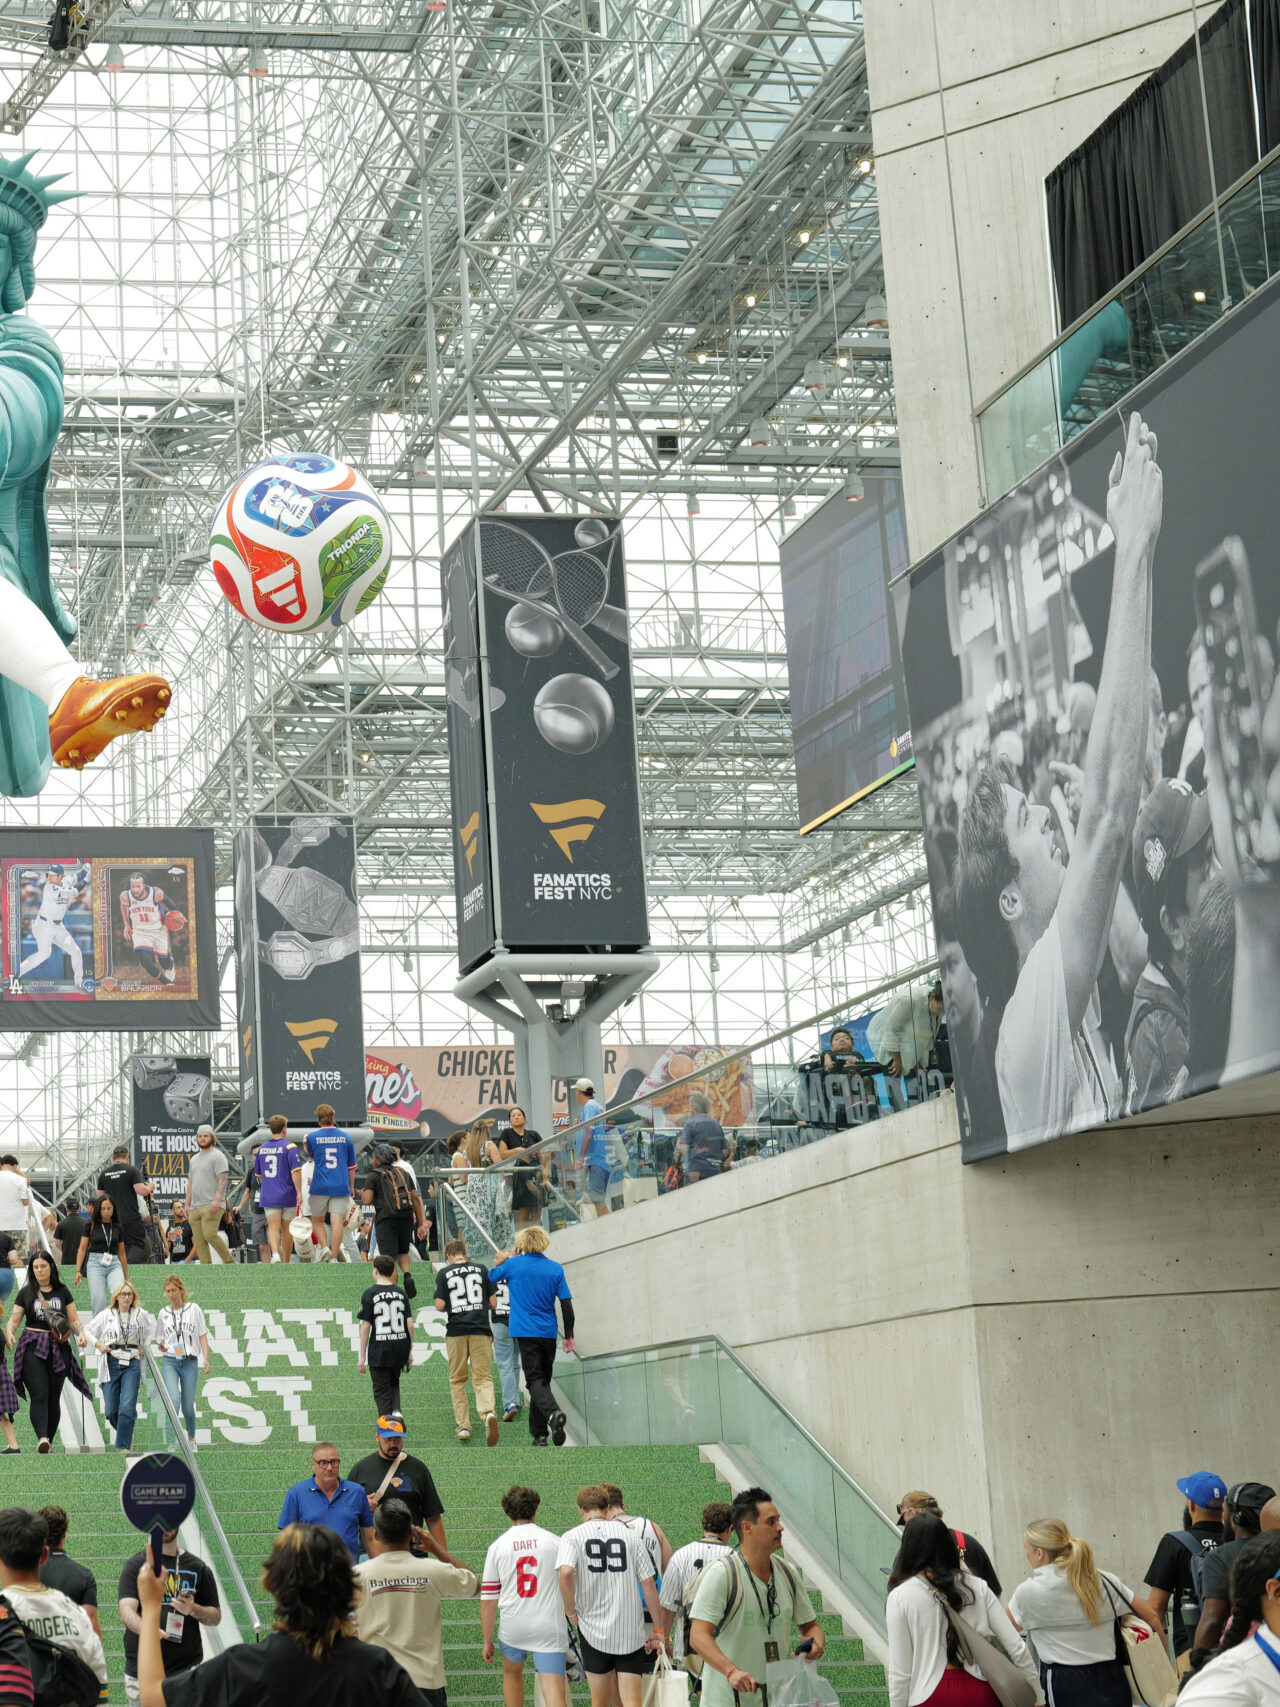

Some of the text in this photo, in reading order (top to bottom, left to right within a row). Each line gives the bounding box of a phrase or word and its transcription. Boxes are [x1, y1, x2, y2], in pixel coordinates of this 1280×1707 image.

[296, 506, 307, 520] FIFA
[327, 522, 370, 561] TRIONDA
[533, 873, 612, 887] FANATICS
[534, 887, 612, 900] FEST NYC
[9, 974, 24, 994] LA
[366, 1059, 389, 1077] ising
[437, 1050, 515, 1077] CHICKE
[285, 1071, 341, 1081] FANATICS
[286, 1080, 342, 1091] FEST NYC
[382, 1116, 414, 1129] FINGERS
[140, 1135, 200, 1153] THE HOUS
[140, 1153, 193, 1176] ALWA
[325, 1147, 338, 1169] 5
[264, 1155, 278, 1178] 3
[445, 1266, 482, 1279] STAFF
[447, 1273, 483, 1308] 26
[372, 1292, 405, 1304] STAFF
[472, 1303, 484, 1311] CITY
[373, 1300, 406, 1334] 26
[166, 1322, 196, 1336] FANTICS
[134, 1487, 183, 1496] GAME PLAN
[512, 1539, 538, 1552] DART
[584, 1538, 628, 1573] 99
[370, 1575, 429, 1589] Balenciaga
[516, 1555, 538, 1598] 6
